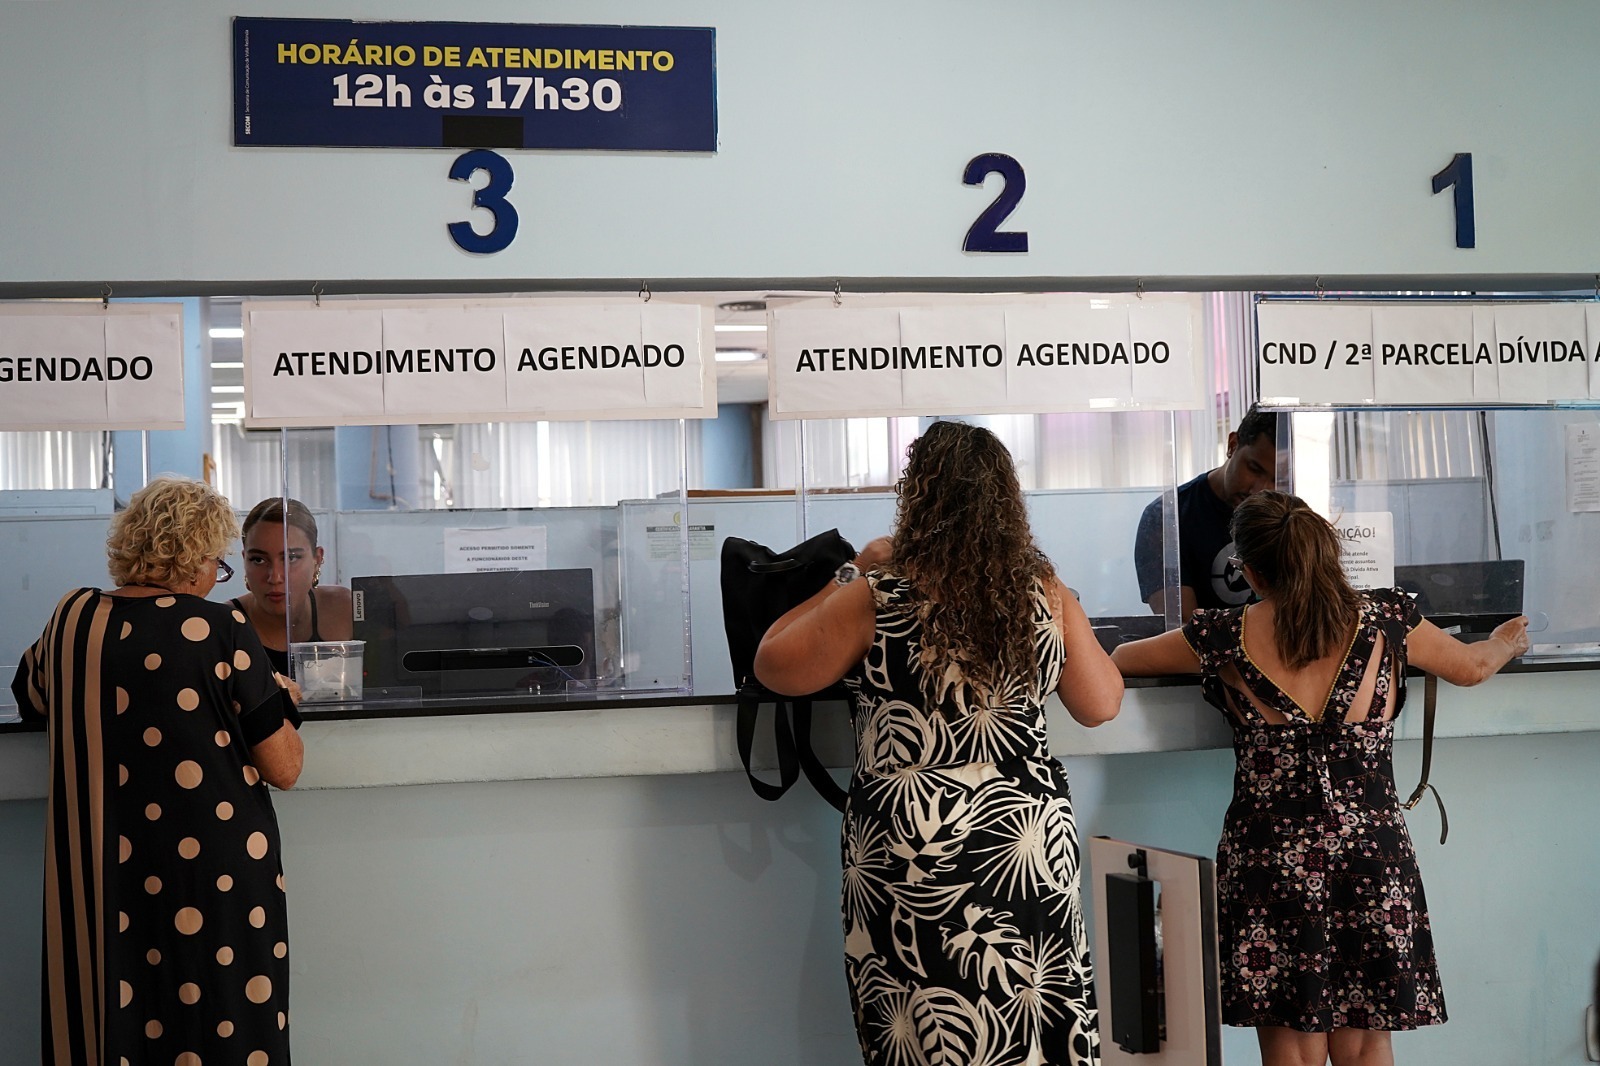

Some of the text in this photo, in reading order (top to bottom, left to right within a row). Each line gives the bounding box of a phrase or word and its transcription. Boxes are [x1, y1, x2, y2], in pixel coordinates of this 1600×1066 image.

[278, 39, 674, 72] HORÁRIO DE ATENDIMENTO
[333, 73, 622, 112] 12h às 17h30
[448, 150, 519, 254] 3
[962, 153, 1029, 252] 2
[1431, 153, 1475, 248] 1
[0, 356, 153, 382] GENDADO
[274, 344, 685, 377] ATENDIMENTO AGENDADO
[796, 341, 1170, 373] ATENDIMENTO AGENDADO
[1263, 343, 1317, 365] CND
[1325, 341, 1337, 370] /
[1346, 343, 1372, 365] 2ª
[1383, 343, 1493, 366] PARCELA
[1499, 336, 1586, 364] DÍVIDA
[1338, 526, 1375, 541] NÇÃO!
